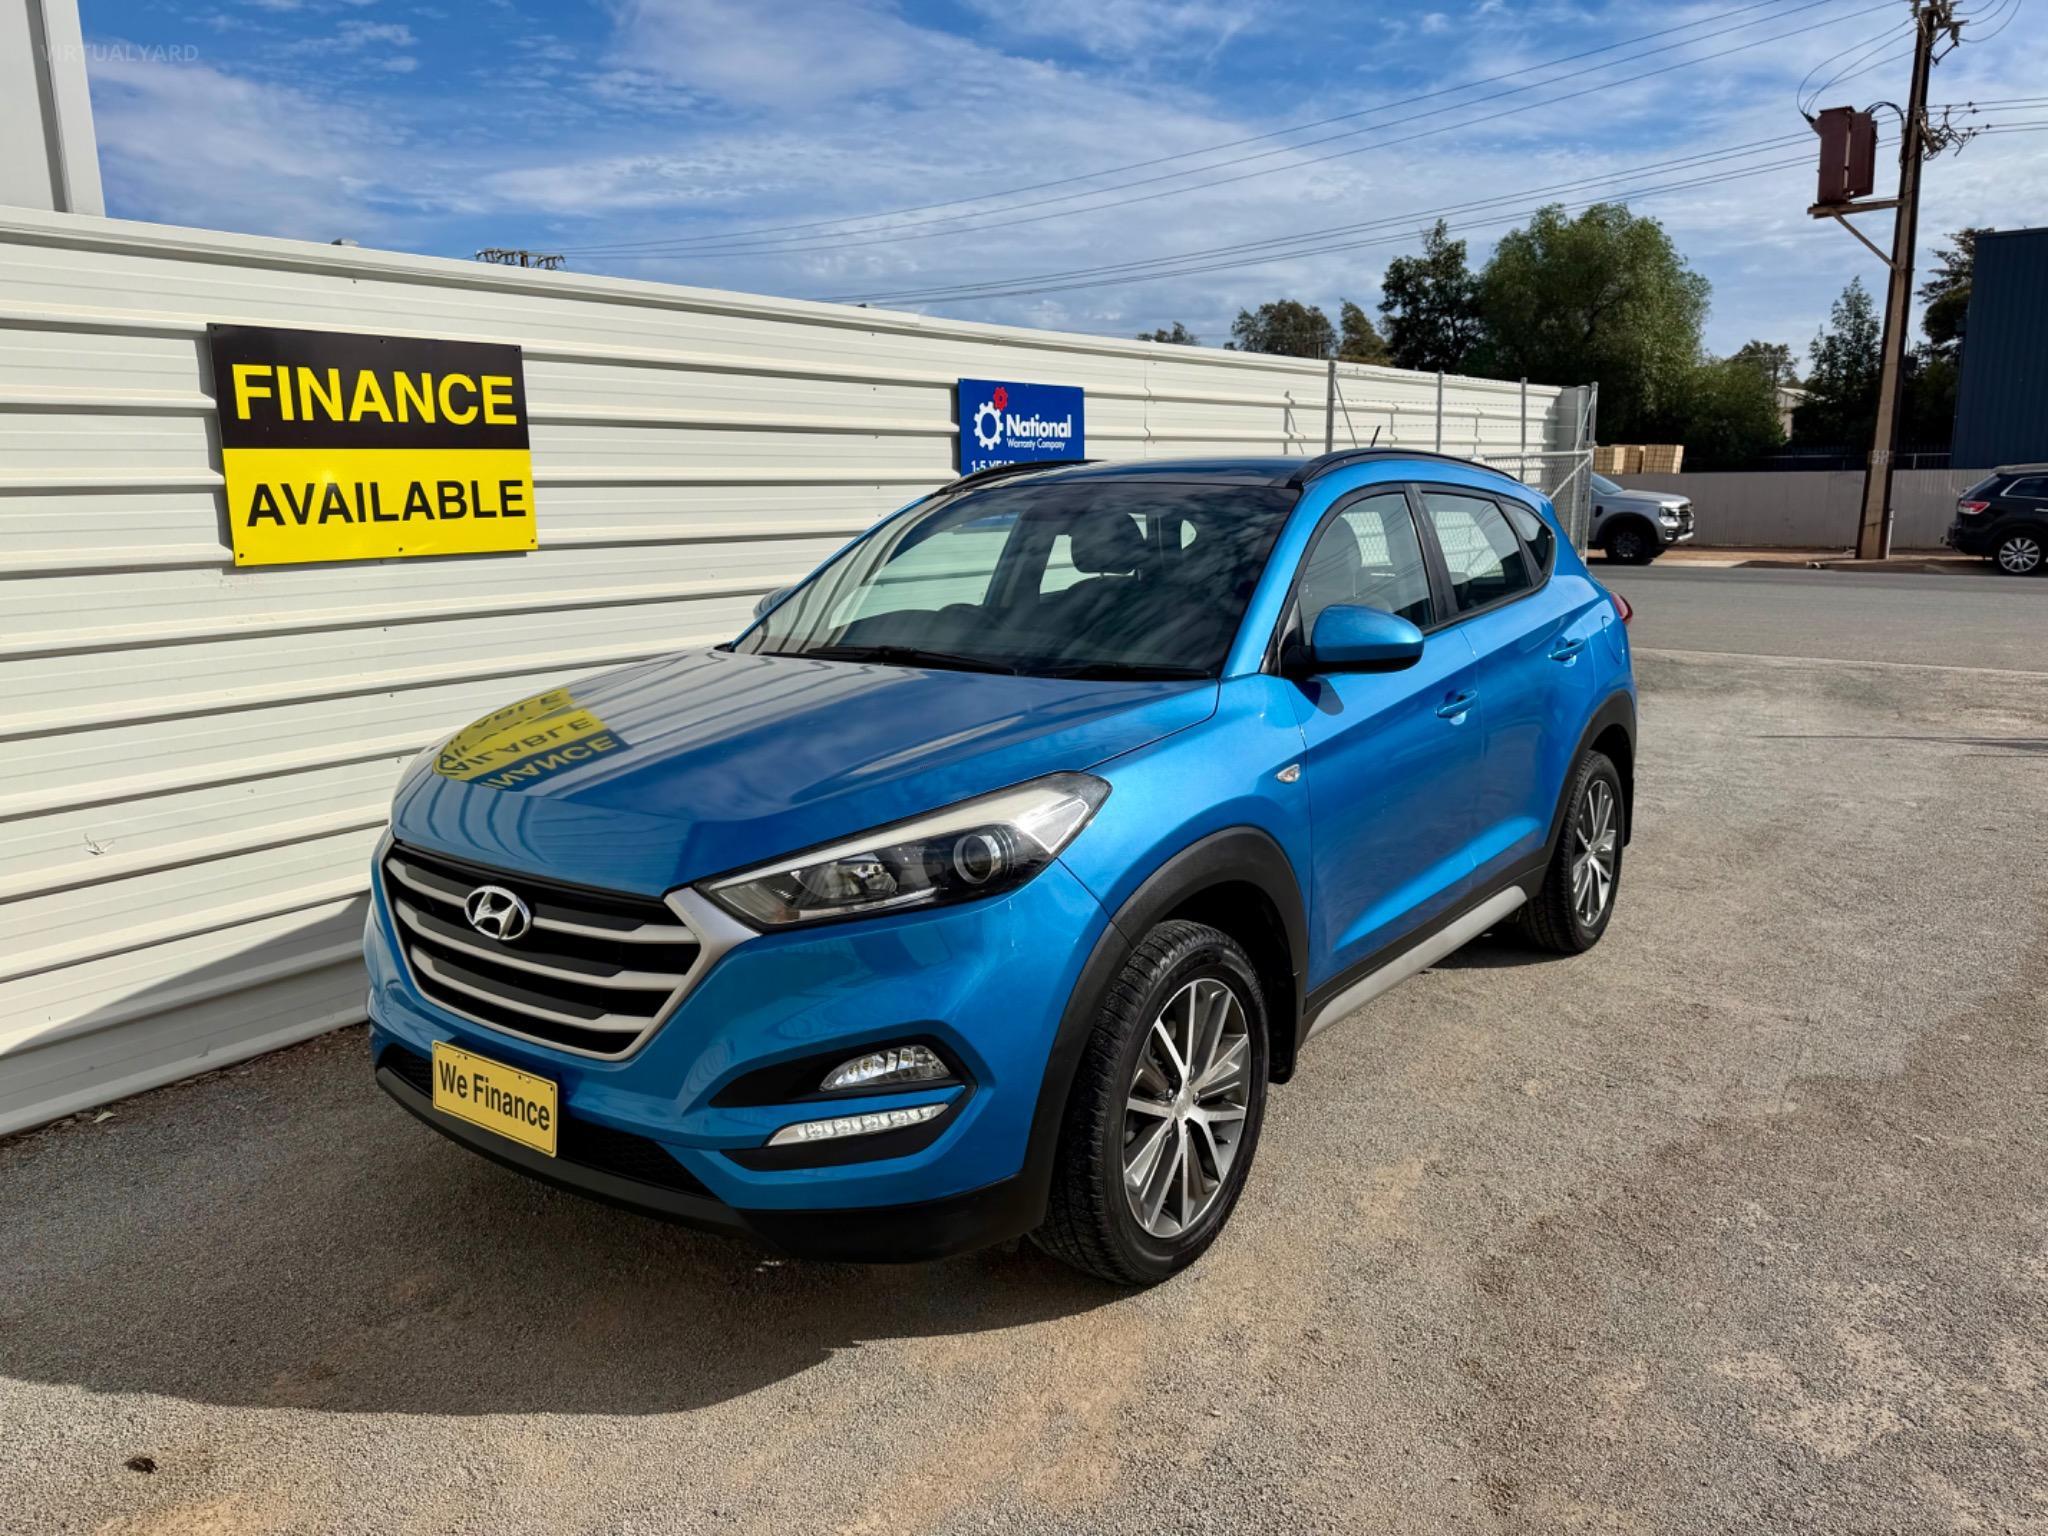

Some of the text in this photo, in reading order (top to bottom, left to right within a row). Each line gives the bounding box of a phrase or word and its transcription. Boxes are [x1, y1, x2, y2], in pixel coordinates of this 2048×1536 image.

[231, 363, 517, 425] FINANCE
[1006, 413, 1072, 438] National
[1007, 437, 1065, 451] Warranty Company
[247, 479, 527, 527] AVAILABLE
[439, 1059, 550, 1131] We Finance
